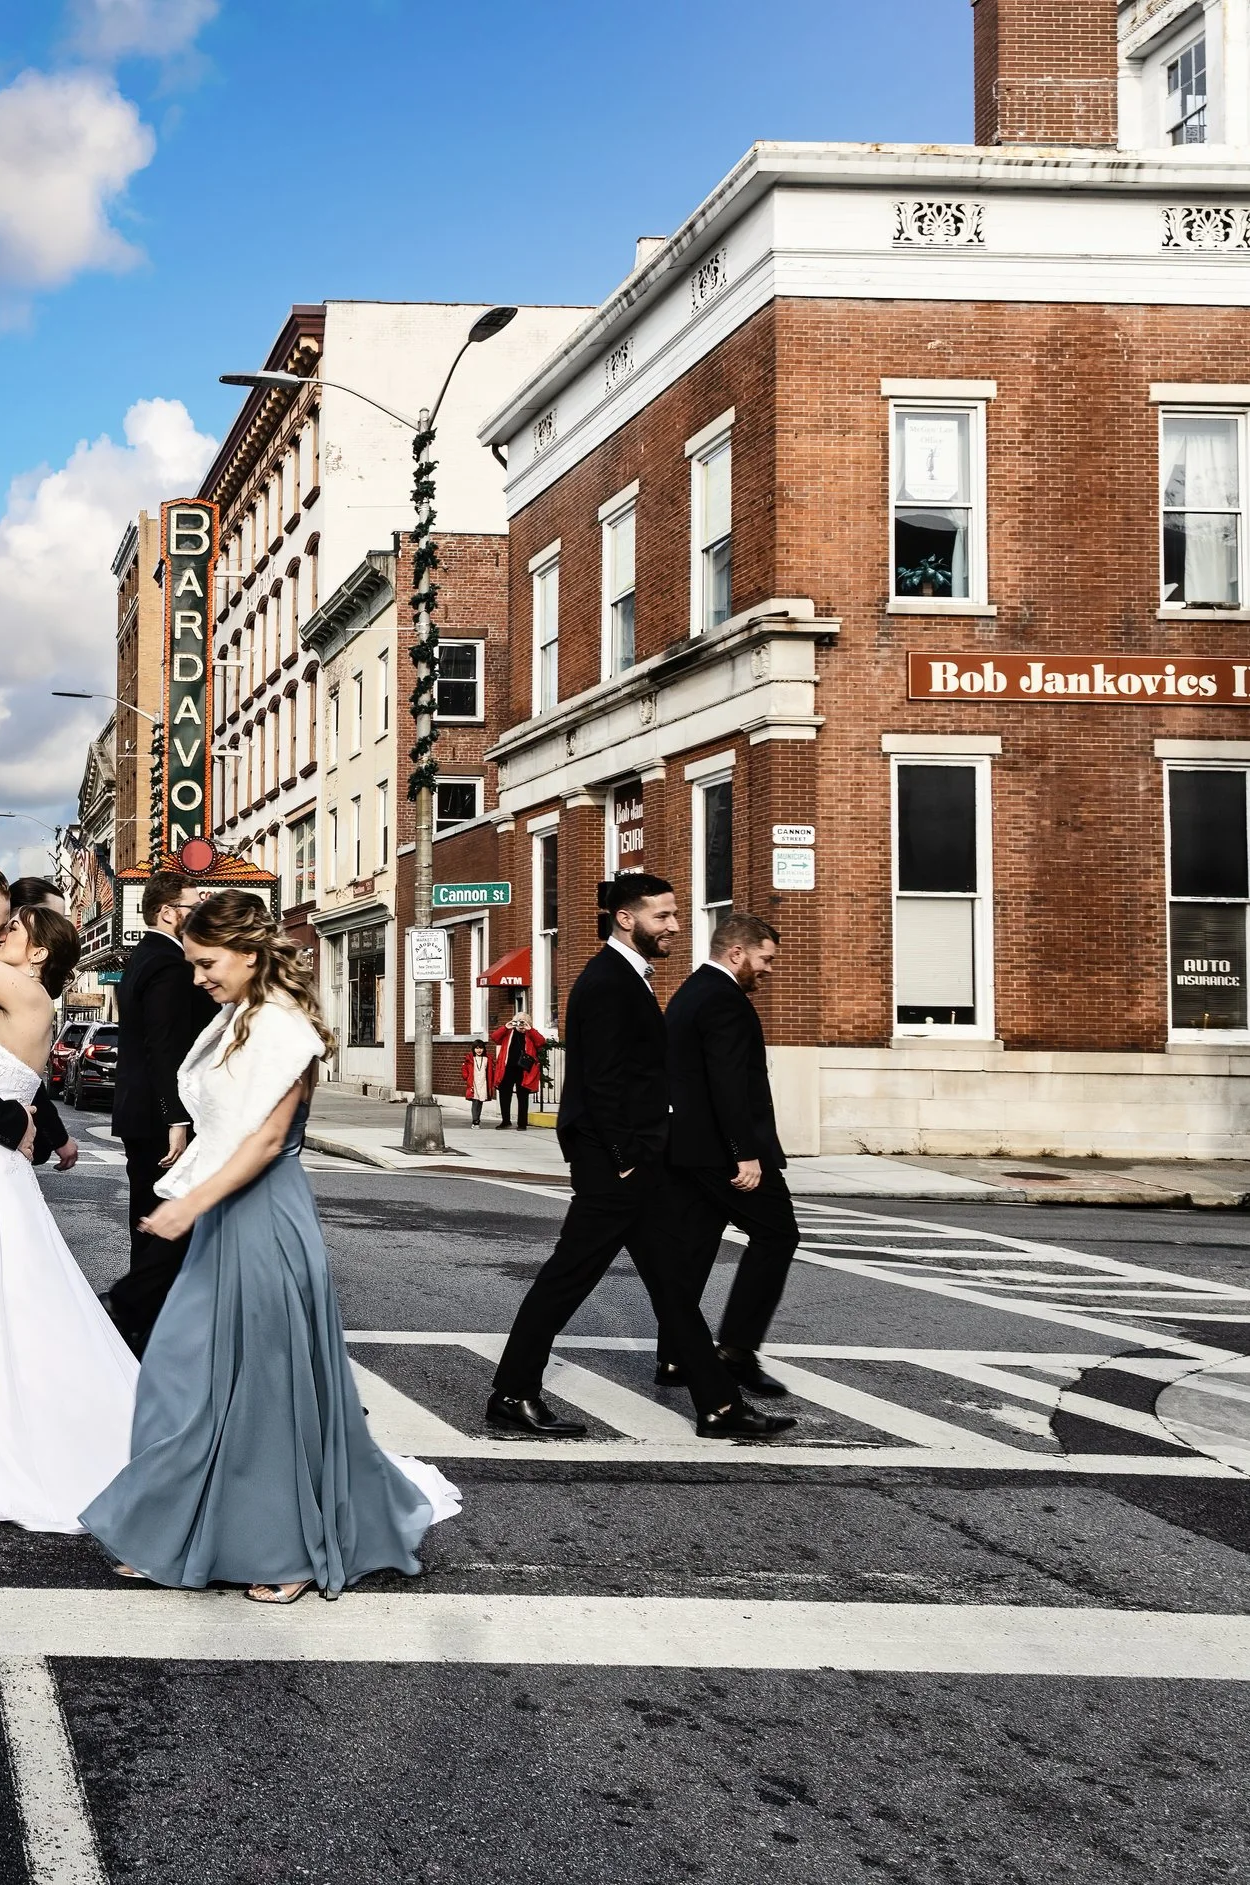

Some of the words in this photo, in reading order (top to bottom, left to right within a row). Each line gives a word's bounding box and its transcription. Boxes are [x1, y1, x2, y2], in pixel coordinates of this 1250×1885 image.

[170, 509, 210, 853] BARDAVON
[928, 661, 1008, 694] Bob
[1019, 662, 1218, 697] Jankovics
[615, 800, 630, 825] Bob
[777, 852, 812, 860] MUNICIPAL
[439, 887, 488, 902] Cannon
[493, 889, 505, 901] St
[123, 930, 146, 942] CEL
[415, 942, 442, 953] Adopted
[1183, 959, 1231, 973] AUTO
[500, 977, 523, 985] ATM
[1176, 975, 1241, 987] INSURANCE
